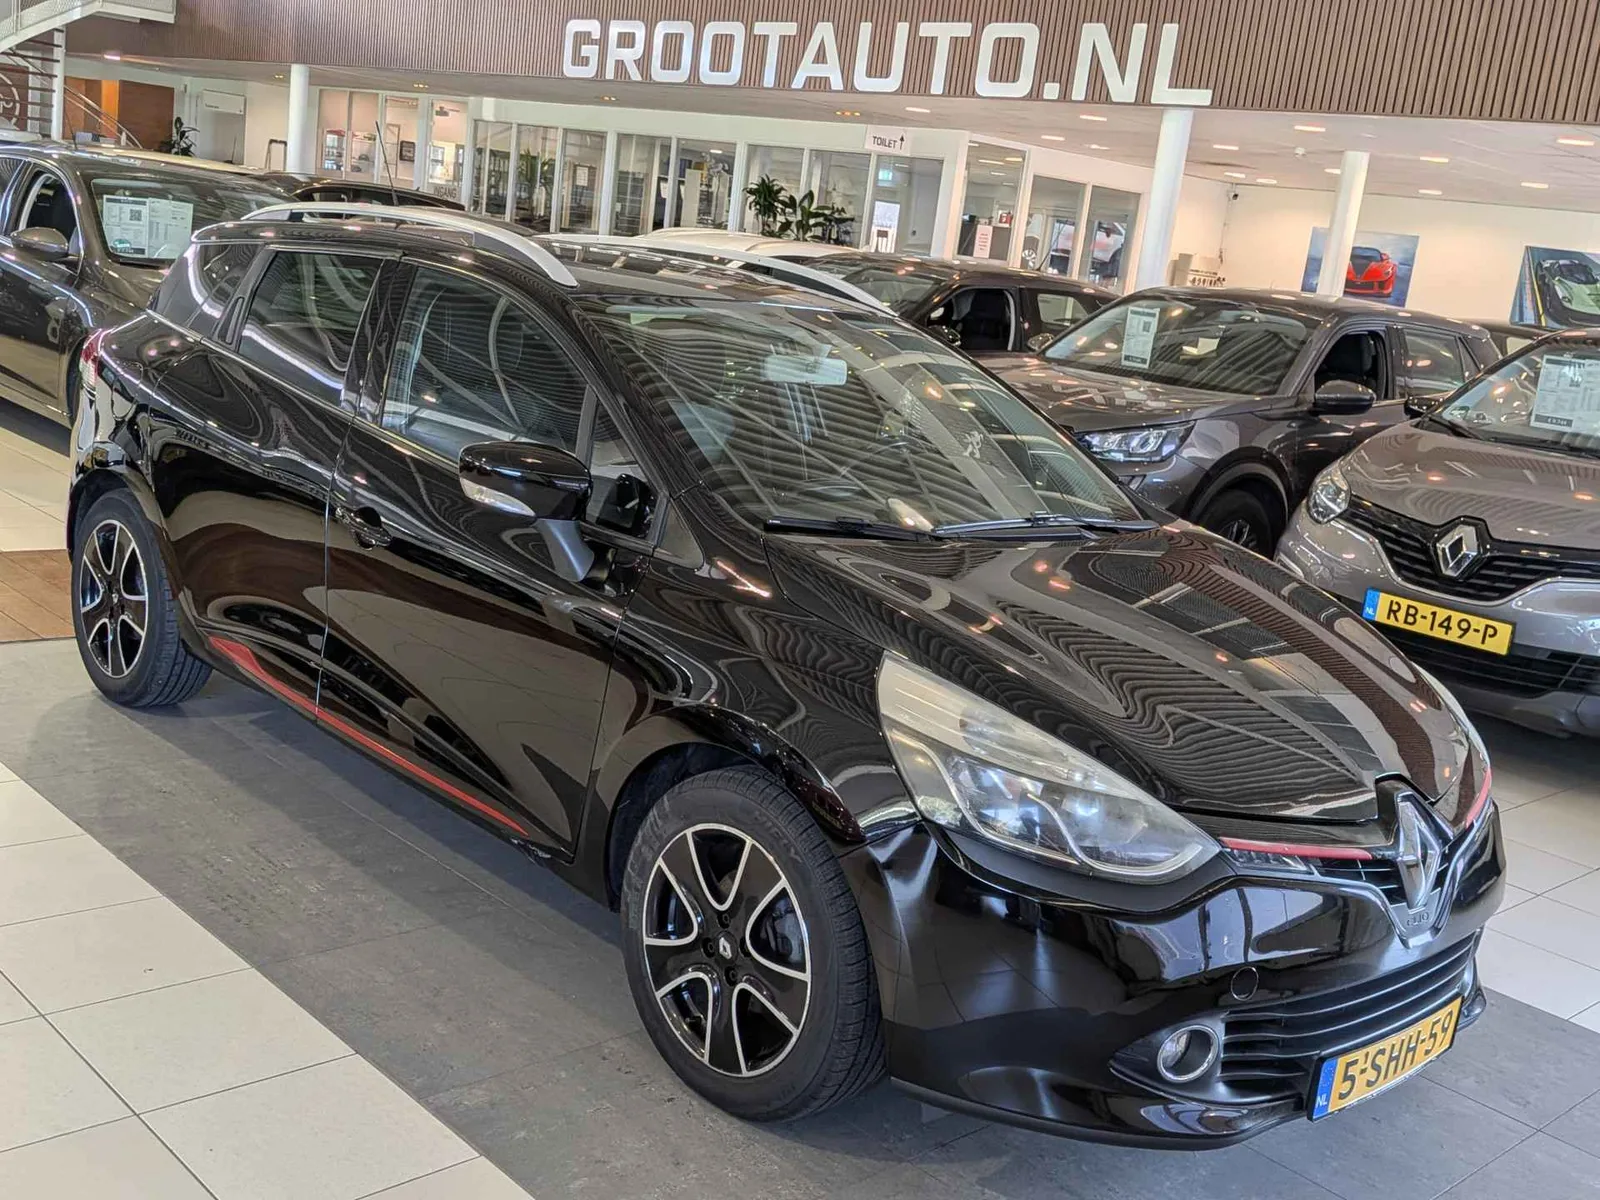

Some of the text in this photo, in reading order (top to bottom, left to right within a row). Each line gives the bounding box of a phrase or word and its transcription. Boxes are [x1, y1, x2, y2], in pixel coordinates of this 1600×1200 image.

[562, 19, 1213, 106] GROOTAUTO.NL
[872, 135, 898, 149] TOILET
[1365, 606, 1376, 616] NL
[1386, 600, 1498, 645] RB-149-P
[1406, 911, 1430, 927] CLIO
[1316, 1094, 1328, 1108] NL
